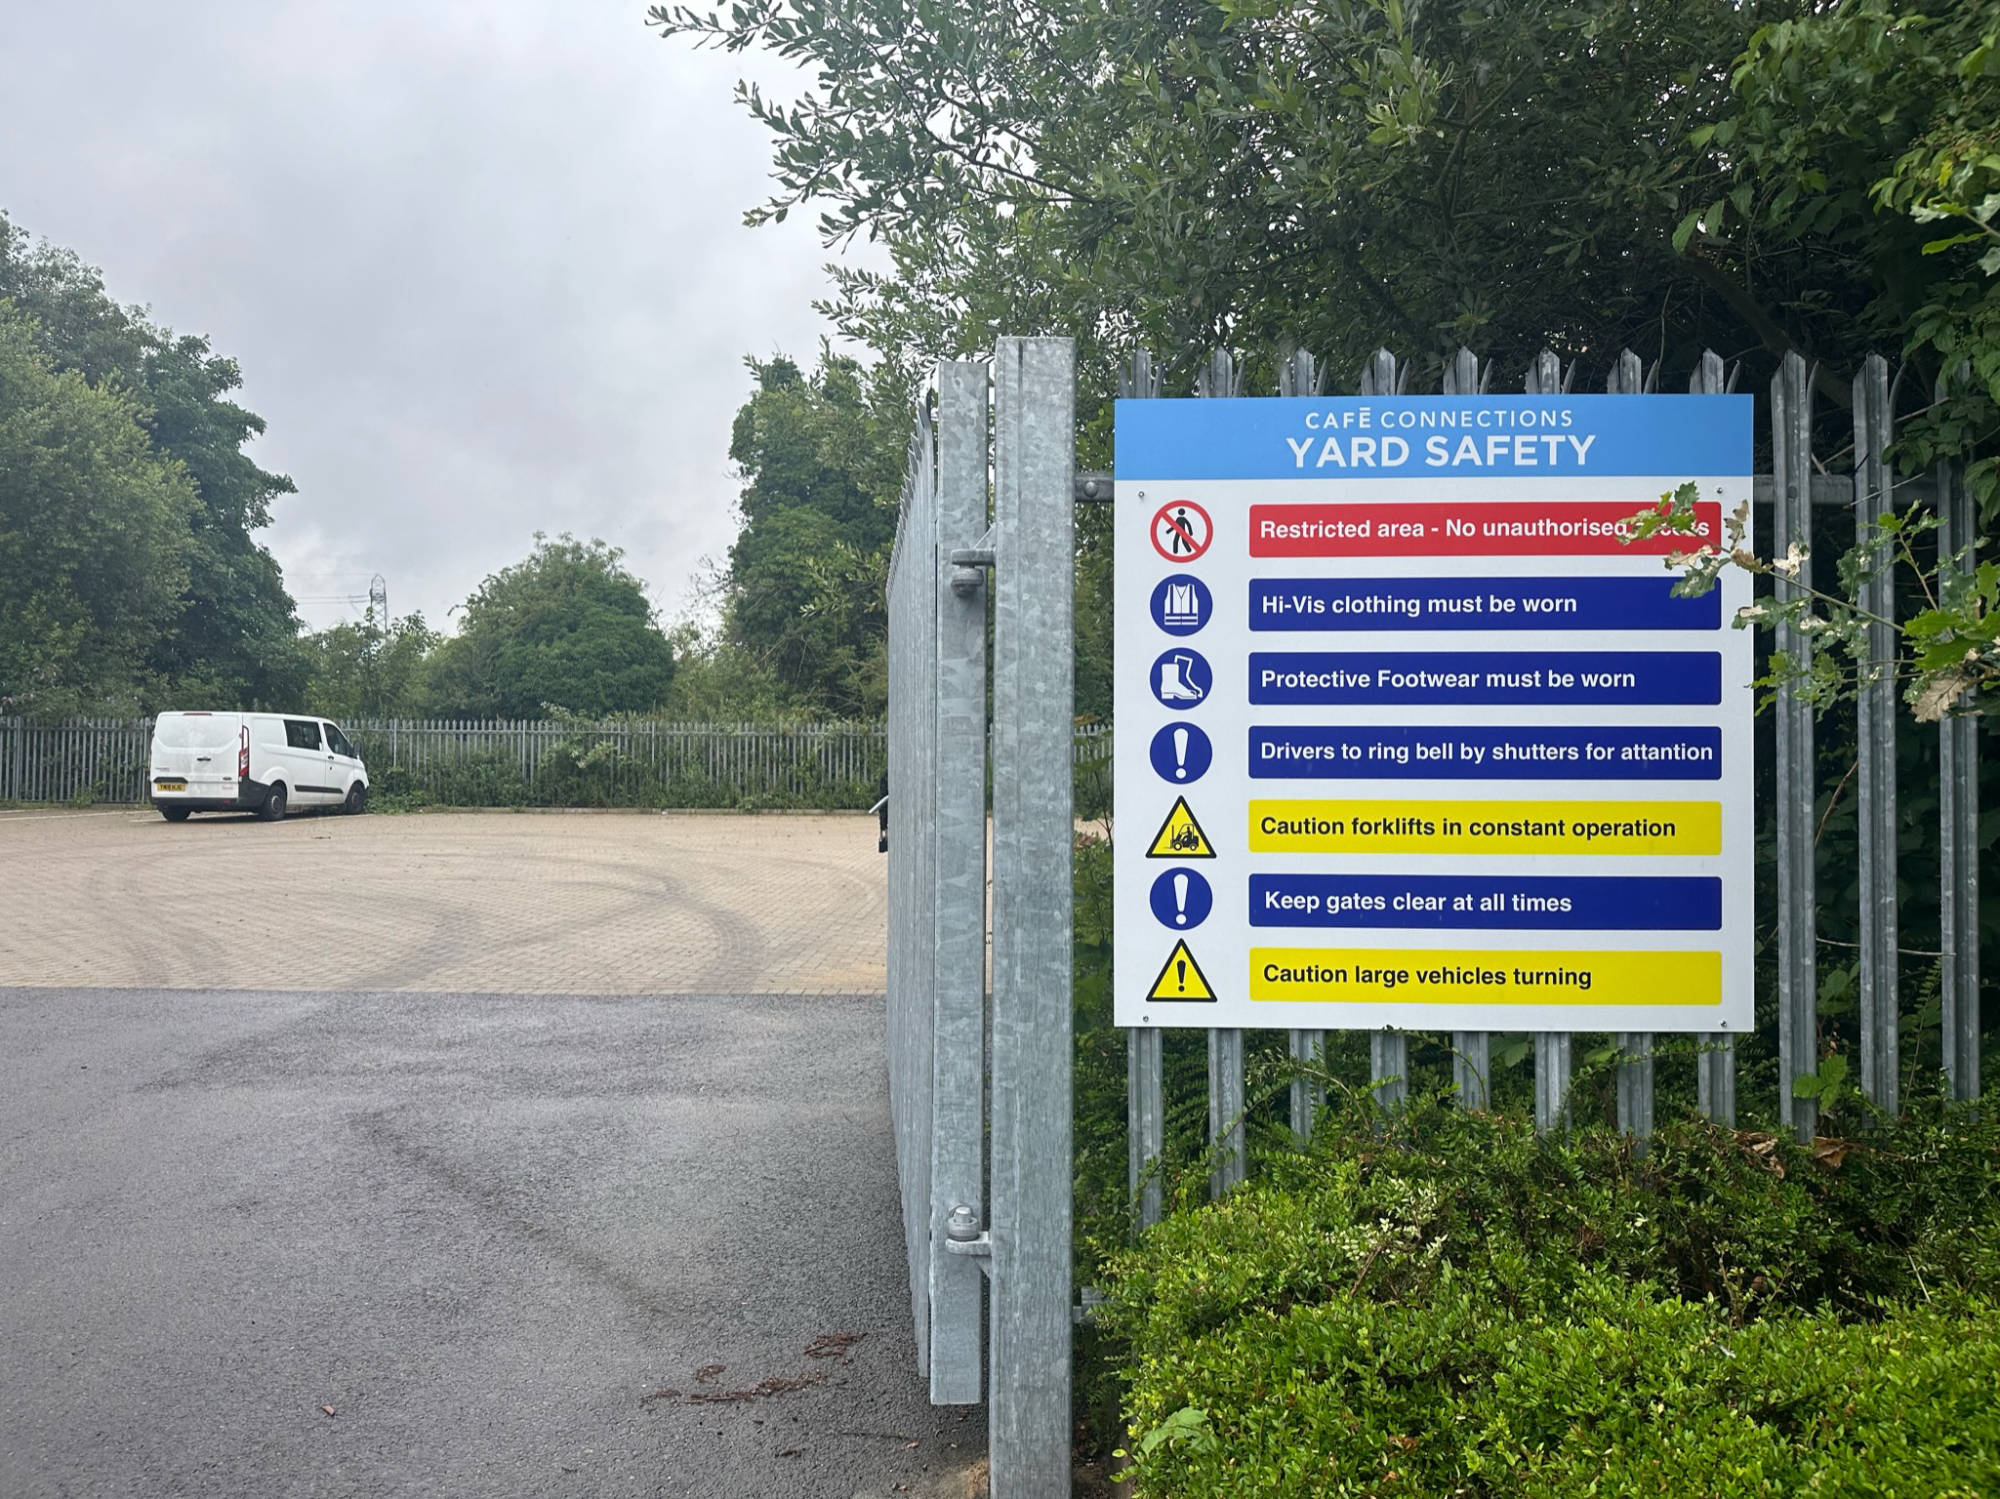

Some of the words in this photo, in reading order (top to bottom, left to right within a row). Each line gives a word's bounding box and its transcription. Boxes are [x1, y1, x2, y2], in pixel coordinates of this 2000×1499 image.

[1381, 410, 1572, 428] CONNECTIONS
[1286, 437, 1410, 468] YARD
[1425, 435, 1595, 466] SAFETY
[1260, 519, 1371, 539] Restricted
[1378, 523, 1424, 538] area
[1446, 518, 1476, 537] No
[1262, 595, 1326, 613] Hi-Vis
[1332, 595, 1421, 618] clothing
[1428, 595, 1483, 613] must
[1490, 595, 1516, 613] be
[1522, 598, 1577, 613] worn
[1261, 669, 1371, 688] Protective
[1377, 669, 1479, 688] Footwear
[1486, 670, 1541, 688] must
[1548, 669, 1574, 688] be
[1580, 673, 1635, 688] worn
[1261, 743, 1334, 760] Drivers
[1341, 743, 1362, 760] to
[1369, 743, 1409, 764] ring
[1416, 742, 1453, 760] bell
[1460, 743, 1486, 765] by
[1492, 743, 1579, 760] shutters
[1585, 743, 1615, 760] for
[1621, 743, 1713, 760] attantion
[1261, 817, 1344, 835] Caution
[1351, 817, 1436, 836] forklifts
[1443, 818, 1462, 836] in
[1469, 819, 1566, 837] constant
[1572, 819, 1676, 841] operation
[1265, 891, 1320, 914] Keep
[1326, 892, 1386, 915] gates
[1393, 892, 1446, 911] clear
[1453, 893, 1474, 911] at
[1480, 893, 1505, 912] all
[1512, 893, 1572, 912] times
[1263, 965, 1348, 983] Caution
[1355, 965, 1409, 989] large
[1416, 966, 1506, 985] vehicles
[1513, 968, 1592, 990] turning
